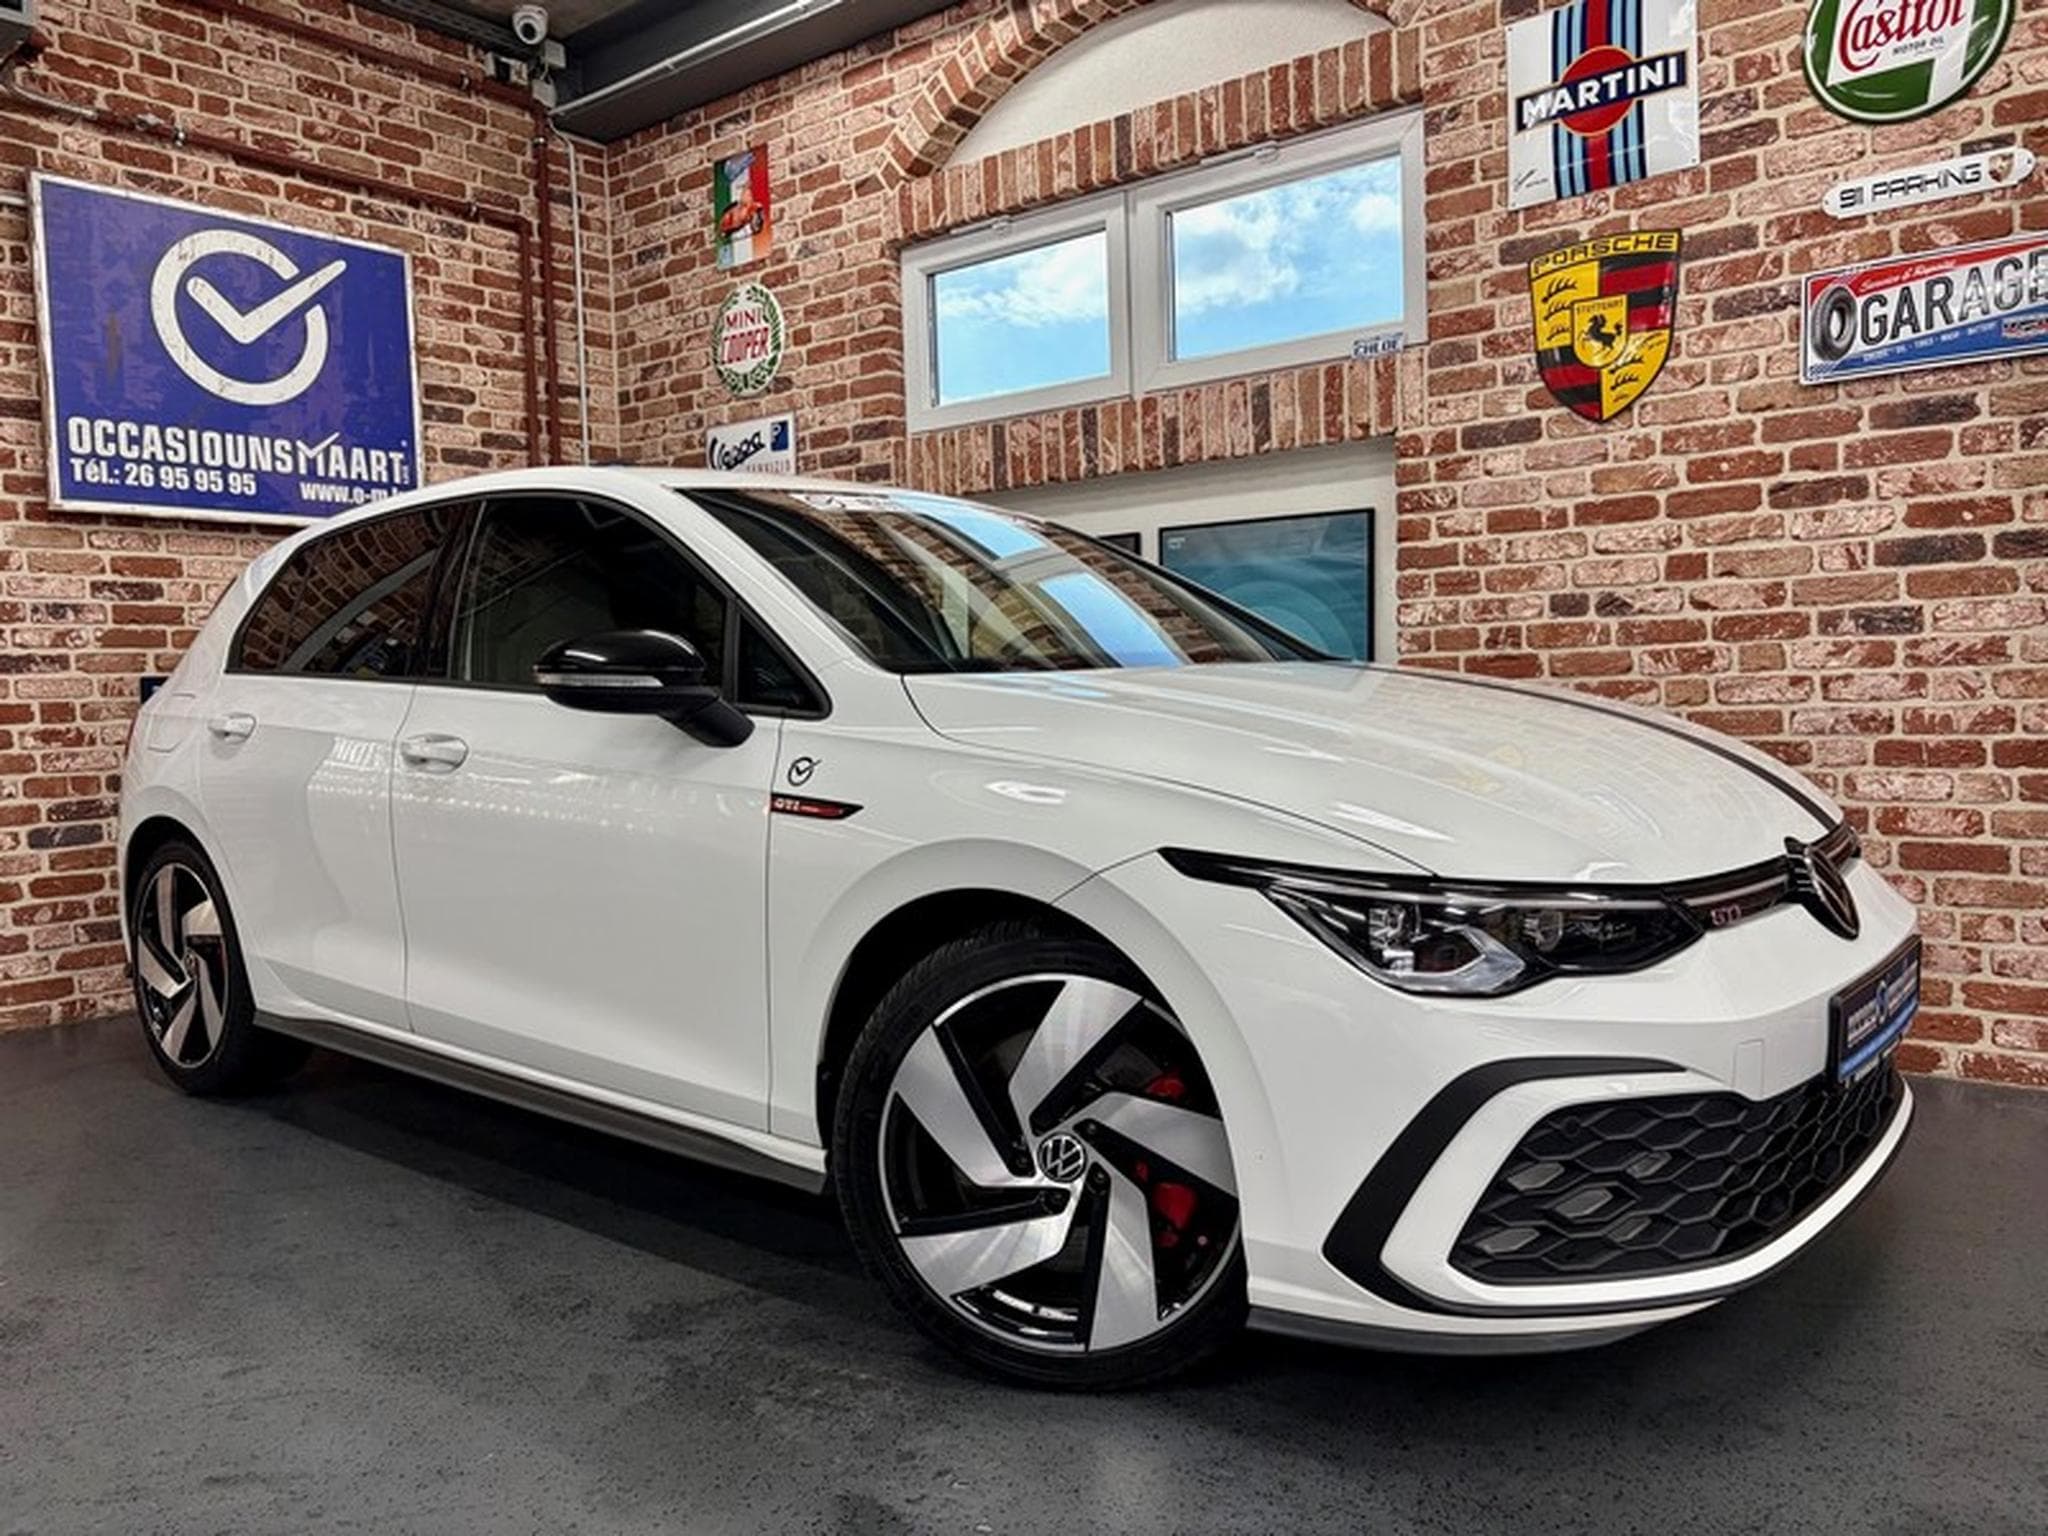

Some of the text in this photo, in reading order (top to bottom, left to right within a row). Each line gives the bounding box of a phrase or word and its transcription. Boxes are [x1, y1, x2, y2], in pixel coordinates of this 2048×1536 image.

[1522, 56, 1678, 128] MARTINI
[1871, 163, 1982, 202] PARKING
[1533, 234, 1675, 275] PORSCHE
[1861, 247, 2048, 346] GARAGE
[723, 307, 762, 332] MINI
[720, 326, 770, 366] COOPER
[708, 430, 766, 471] Vespa
[124, 462, 155, 488] 26
[159, 465, 191, 491] 95
[194, 468, 225, 494] 95
[227, 472, 257, 496] 95
